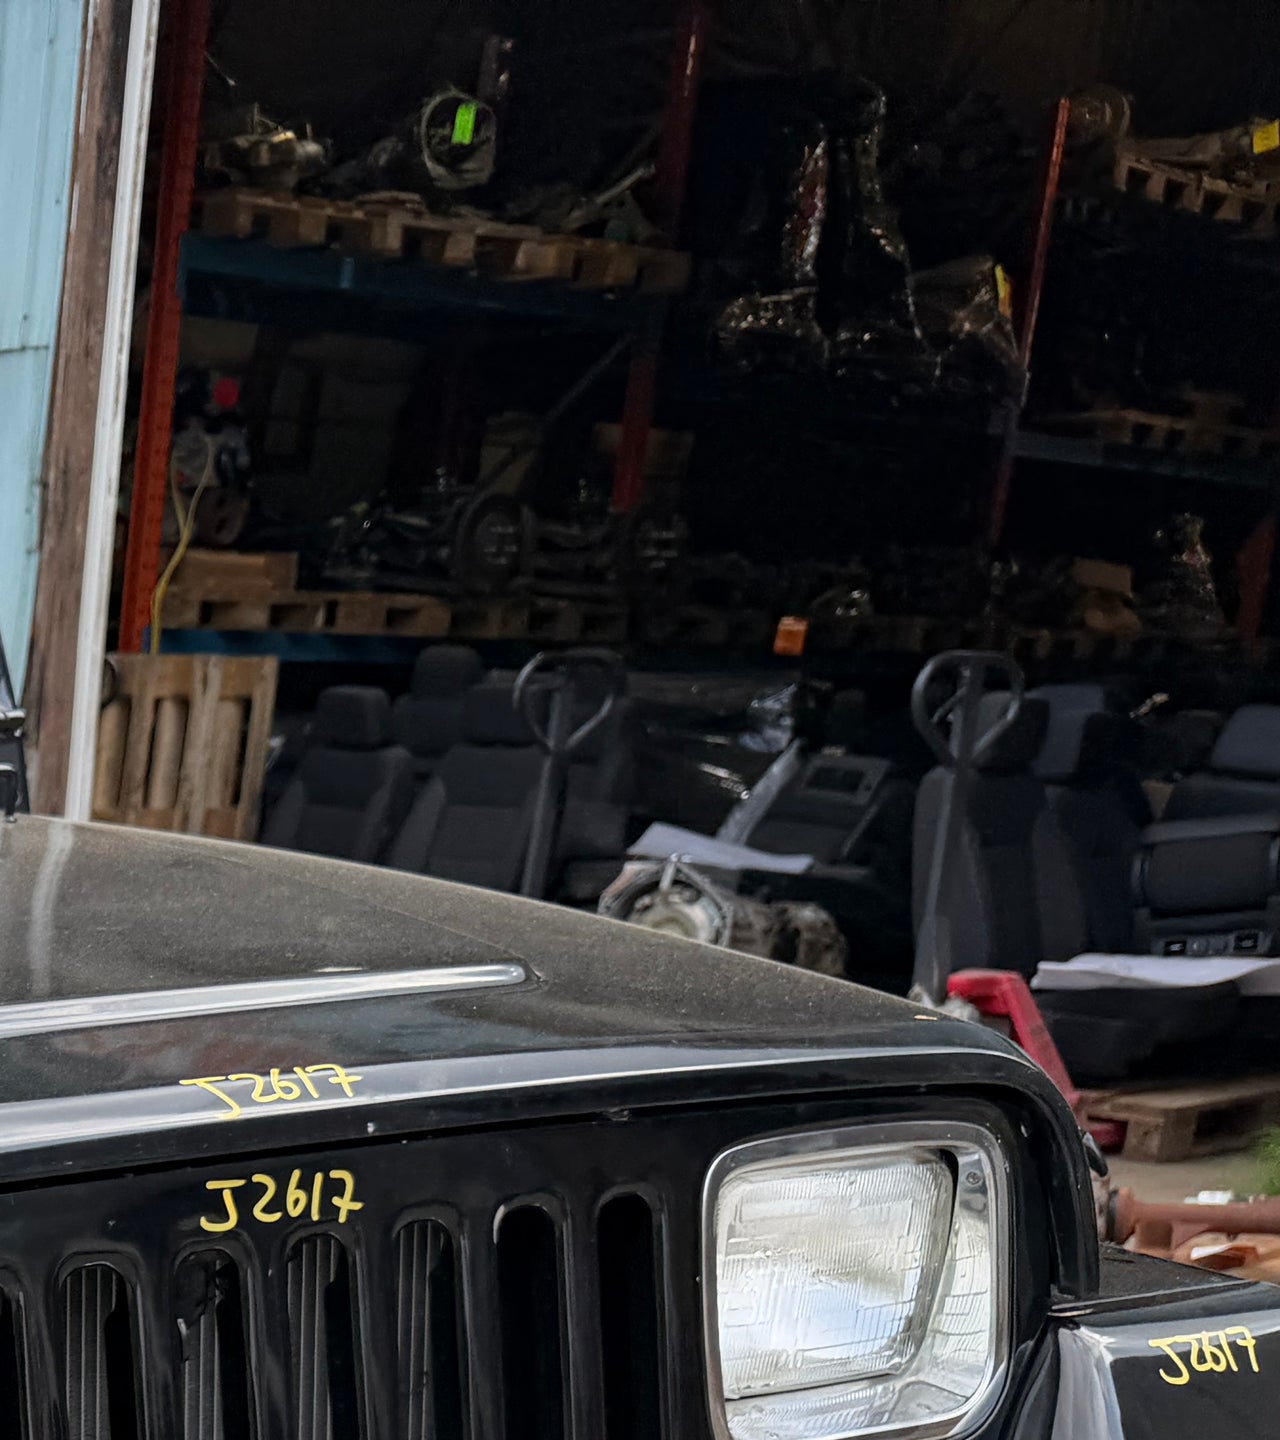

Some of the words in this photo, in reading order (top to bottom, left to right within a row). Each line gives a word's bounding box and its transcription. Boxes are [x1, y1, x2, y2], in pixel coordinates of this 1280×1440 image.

[178, 1063, 363, 1120] J2617
[199, 1168, 365, 1232] J2617
[1148, 1325, 1260, 1385] J2617
